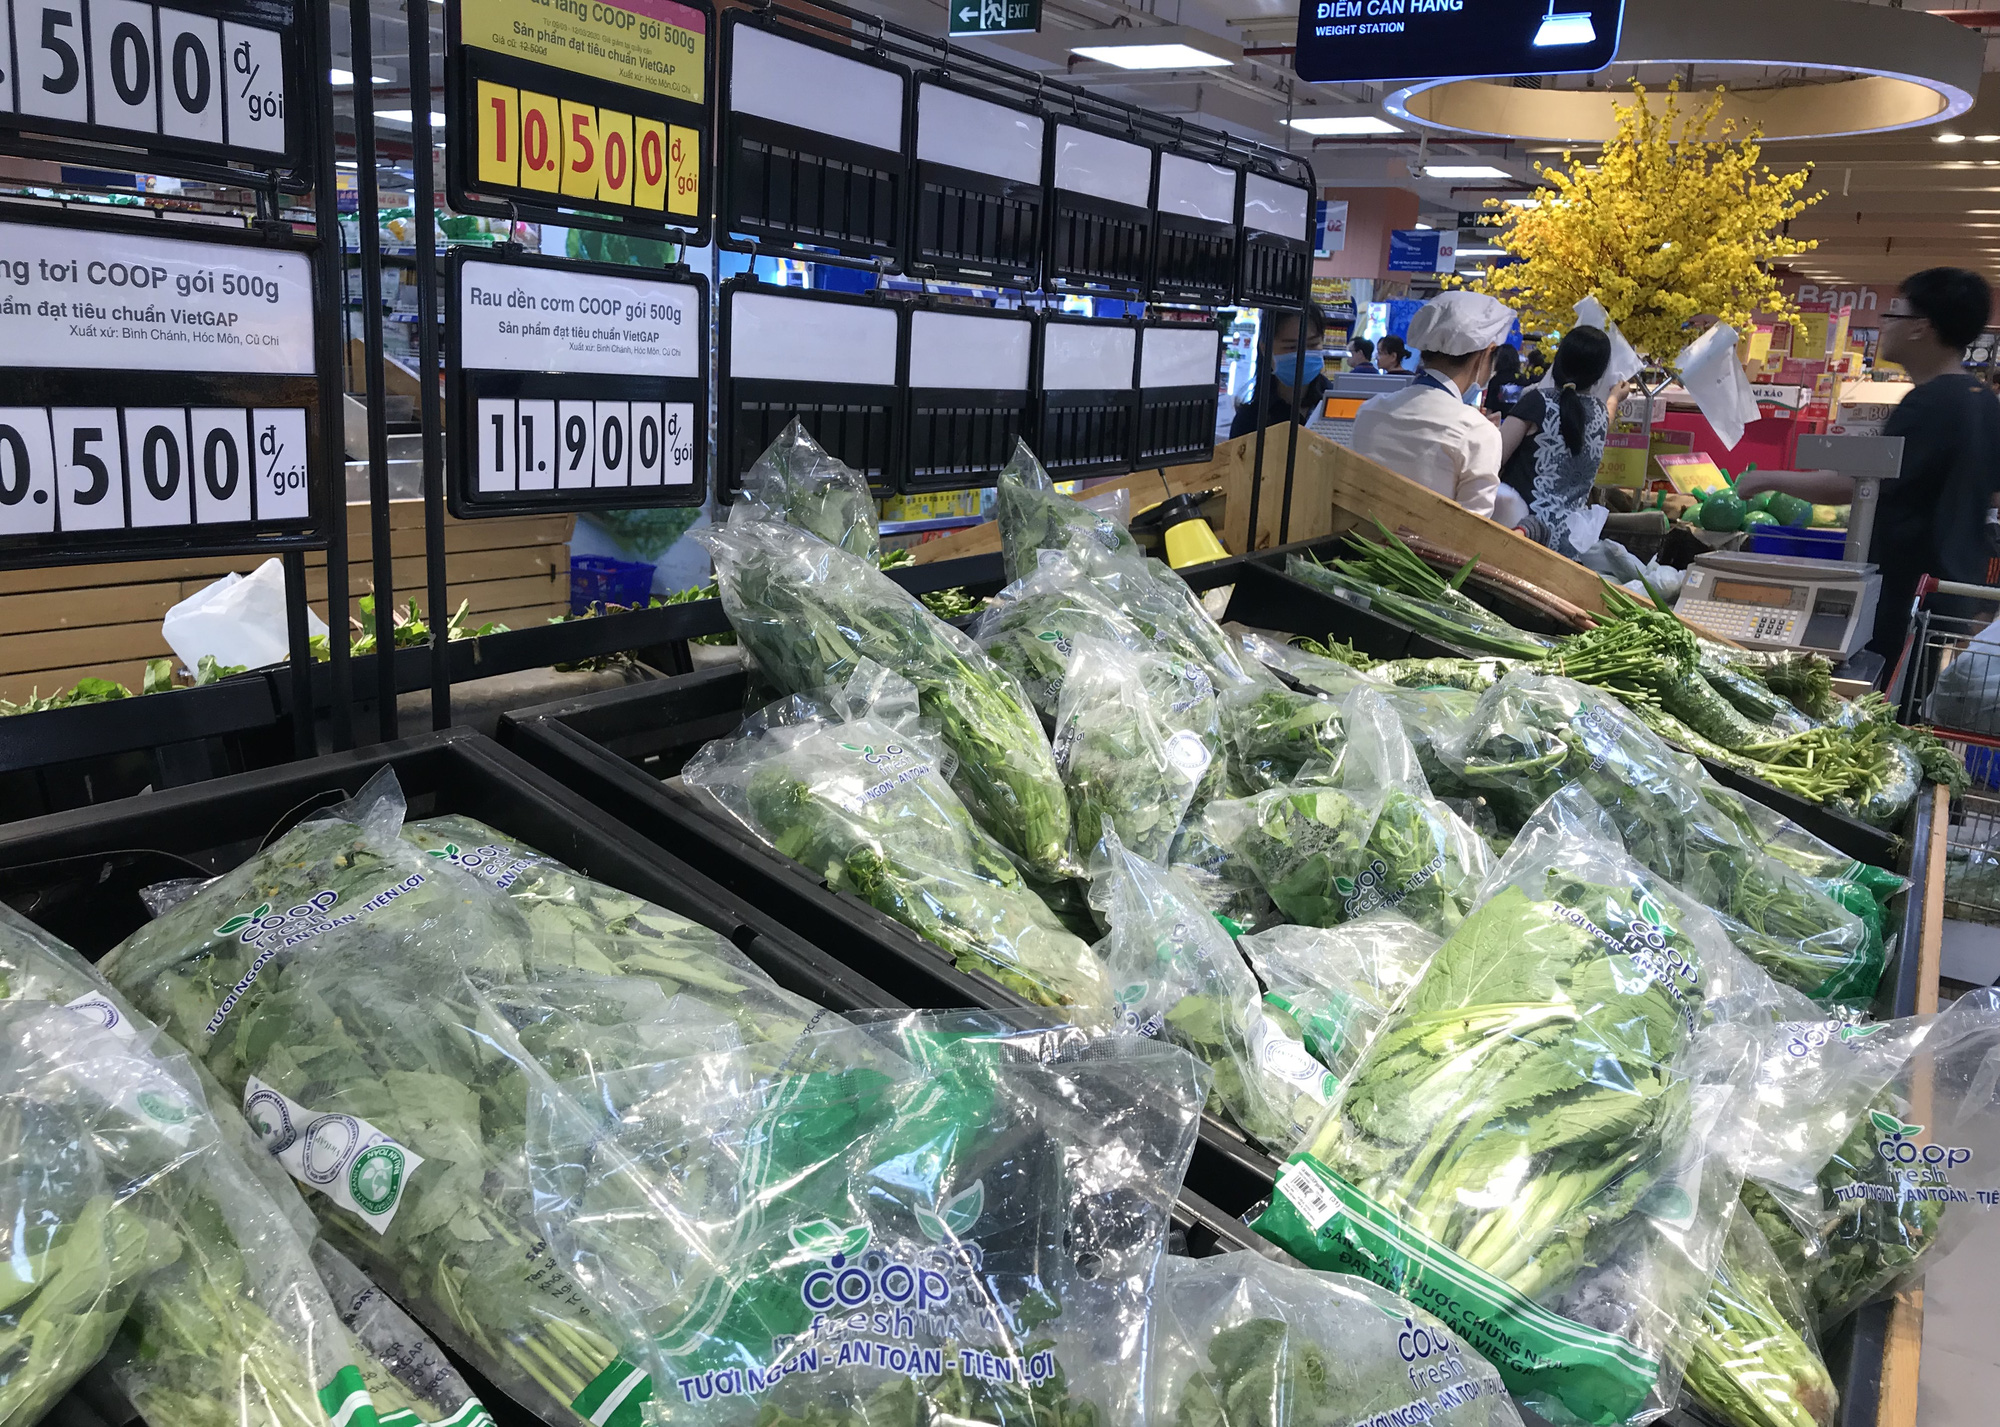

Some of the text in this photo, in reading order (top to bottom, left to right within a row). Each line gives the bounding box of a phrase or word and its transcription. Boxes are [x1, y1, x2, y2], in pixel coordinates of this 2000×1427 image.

[1008, 4, 1029, 18] EXIT
[492, 33, 505, 46] Giá
[593, 4, 636, 31] COOP
[639, 20, 660, 40] gói
[664, 26, 695, 54] 500g
[1316, 22, 1405, 36] WEIGHT STATION
[513, 20, 676, 77] Sản phẩm đạt tiêu chuẩn VietGAP
[682, 84, 692, 95] Chi
[491, 97, 662, 190] 10.500
[1327, 220, 1342, 232] 02
[1440, 246, 1453, 257] 03
[38, 258, 78, 283] tơi
[87, 261, 168, 289] COOP
[176, 270, 214, 297] gói
[222, 274, 279, 303] 500g
[470, 287, 682, 325] Rau dền cơm COOP gói 500g
[1799, 285, 1878, 311] Bánh
[37, 301, 67, 321] đạt
[72, 303, 106, 319] tiêu
[112, 304, 166, 323] chuẩn
[171, 308, 238, 327] VietGAP
[69, 324, 279, 346] Xuất xứ: Bình Chánh, Hóc Môn, Củ Chi
[498, 321, 660, 343] Sản phẩm đạt tiêu chuẩn VietGAP
[491, 414, 659, 471] 11.900
[866, 779, 895, 801] NGON
[254, 914, 326, 949] fresh
[1586, 922, 1624, 952] NGON
[206, 995, 238, 1034] TƯƠI
[236, 949, 275, 995] NGON
[286, 930, 310, 948] AN
[363, 887, 399, 912] TIỆN
[398, 873, 426, 893] LỢI
[1329, 1194, 1341, 1208] (31)
[1907, 1188, 1931, 1202] AN
[1932, 1186, 1968, 1203] TOÀN
[525, 1267, 546, 1284] Tên
[1339, 1251, 1370, 1277] ĐẠT
[812, 1310, 914, 1338] fresh
[1409, 1279, 1461, 1316] ĐƯỢC
[1463, 1309, 1521, 1356] CHỨNG
[679, 1341, 1055, 1402] TƯƠI NGON AN TOÀN TIỆN LỢI
[1409, 1355, 1467, 1391] fresh
[1438, 1384, 1464, 1411] AN
